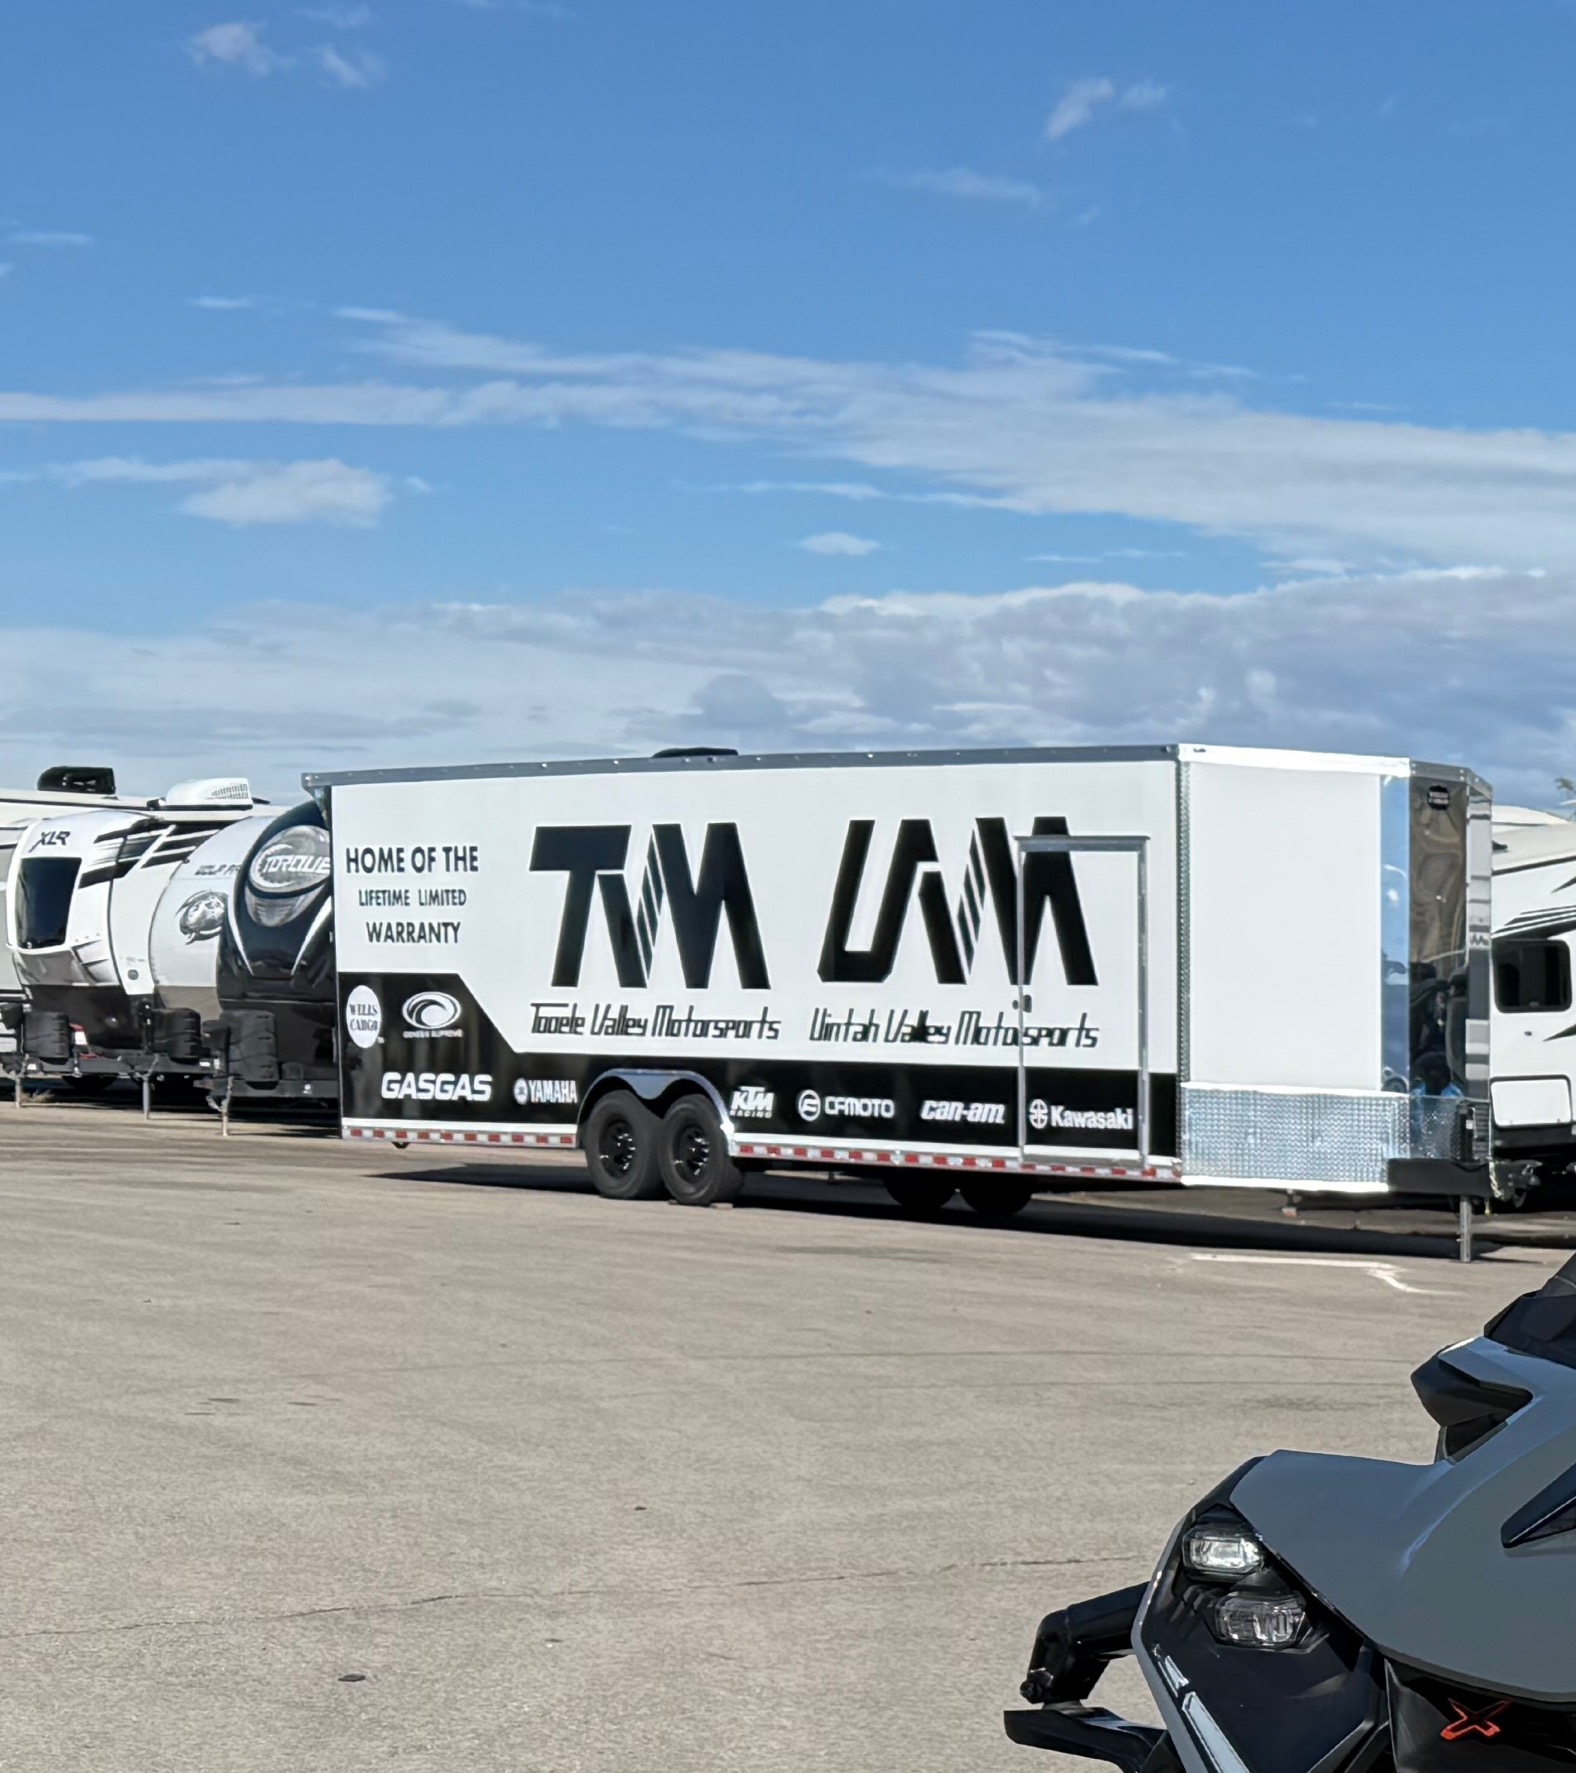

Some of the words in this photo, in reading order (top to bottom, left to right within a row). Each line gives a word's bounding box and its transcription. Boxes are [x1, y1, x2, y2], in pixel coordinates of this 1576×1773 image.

[29, 831, 70, 853] XLR
[346, 847, 405, 873] HOME
[411, 846, 436, 873] OF
[442, 846, 479, 872] THE
[359, 889, 411, 907] LIFETIME
[418, 889, 467, 907] LIMITED
[366, 922, 461, 944] WARRANTY
[591, 1003, 648, 1036] Valley
[651, 1004, 781, 1040] Motorsports
[381, 1072, 493, 1101] GASGAS
[528, 1080, 578, 1103] YAMAHA
[731, 1086, 774, 1111] KTM
[825, 1096, 894, 1118] CFMOTO
[730, 1109, 772, 1118] RACING
[921, 1100, 1005, 1124] can-am
[1050, 1105, 1134, 1130] Kawasaki
